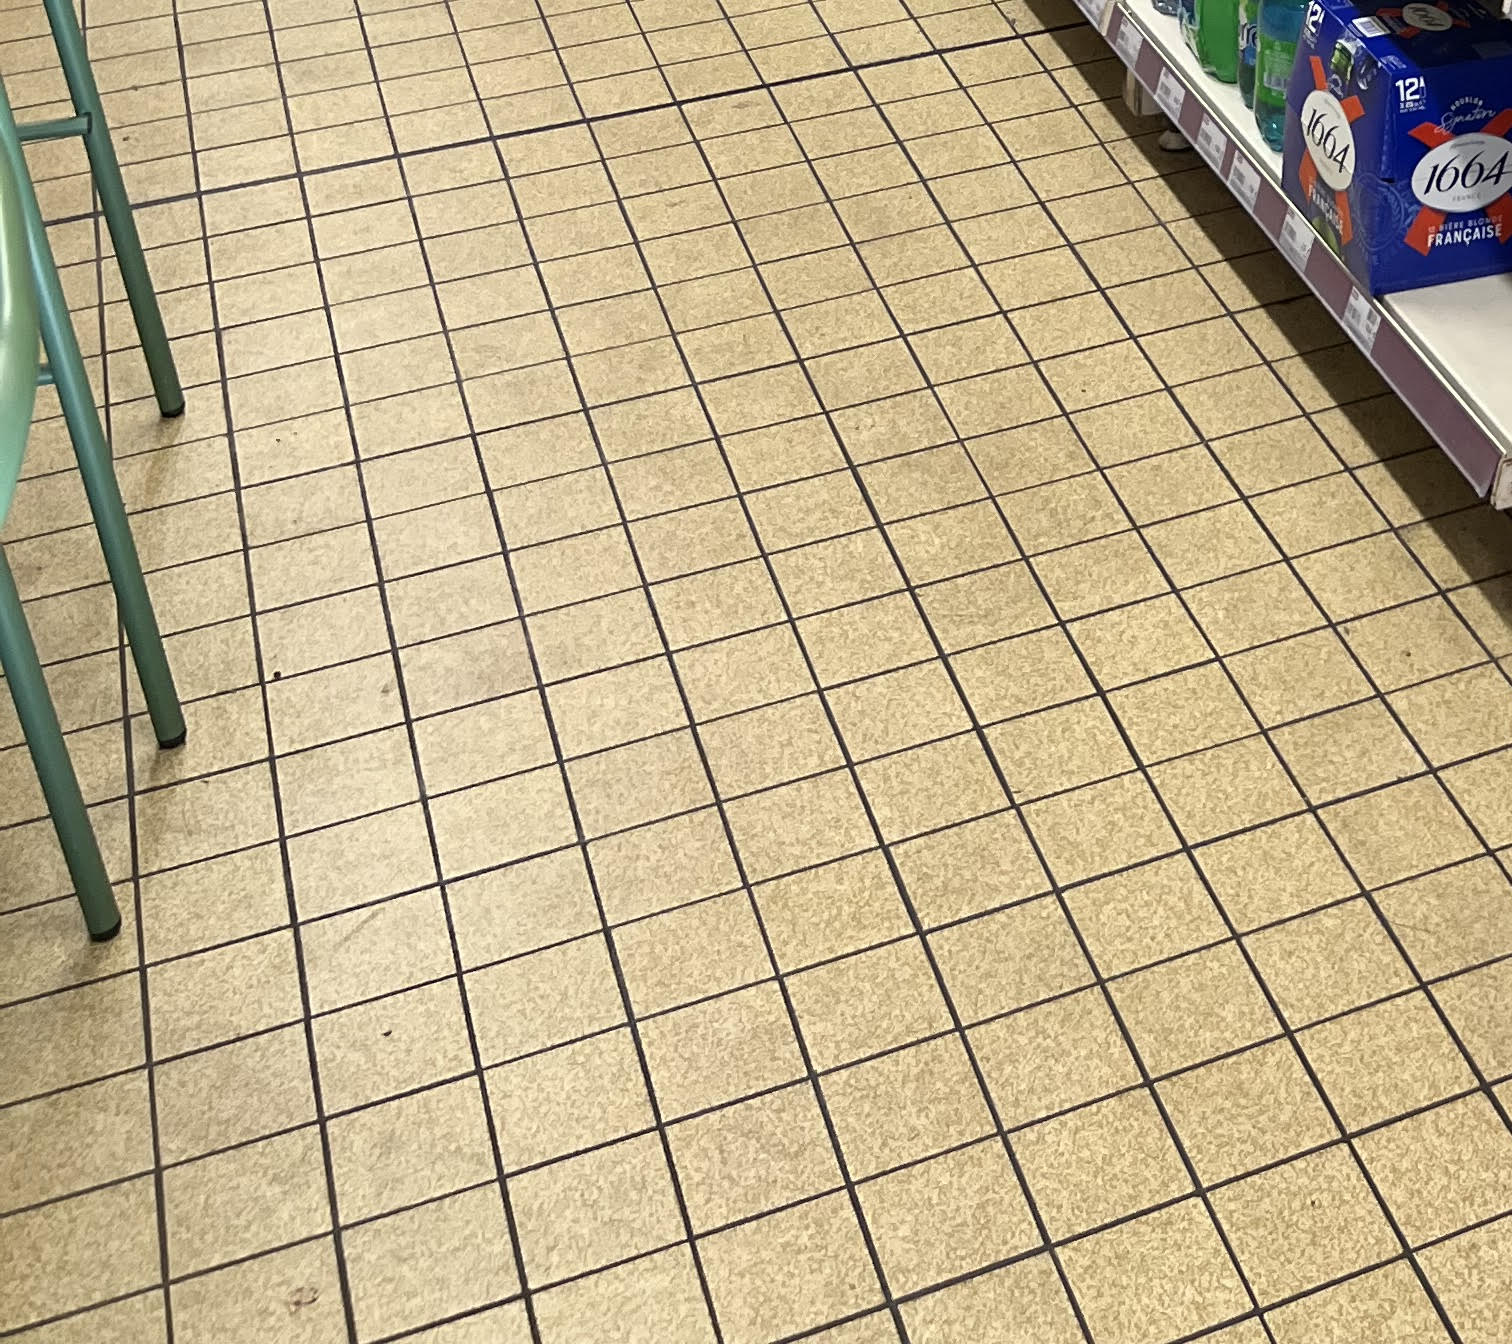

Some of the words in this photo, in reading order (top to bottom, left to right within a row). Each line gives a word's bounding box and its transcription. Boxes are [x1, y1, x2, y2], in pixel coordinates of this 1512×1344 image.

[1307, 0, 1323, 33] 12
[1395, 78, 1419, 103] 12
[1303, 110, 1352, 176] 1664
[1426, 222, 1504, 250] FRANÇAISE
[1466, 214, 1503, 230] BLONDE
